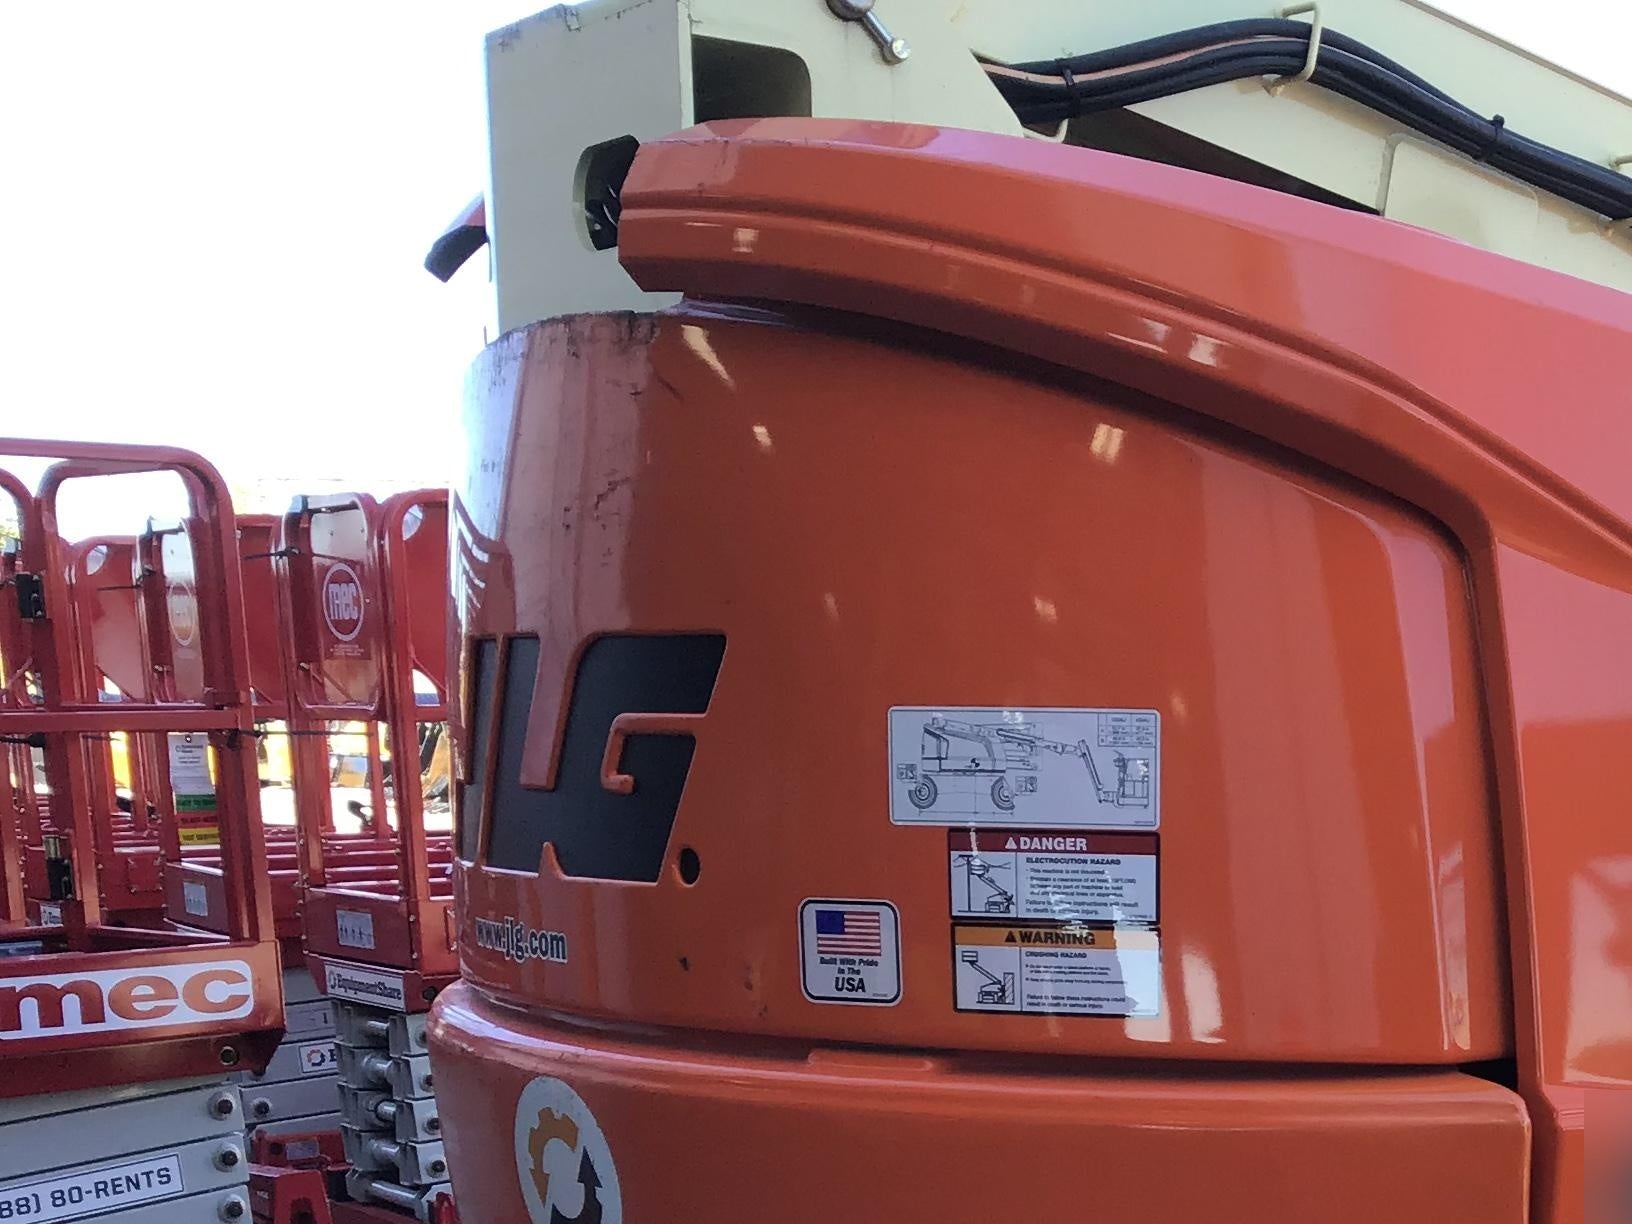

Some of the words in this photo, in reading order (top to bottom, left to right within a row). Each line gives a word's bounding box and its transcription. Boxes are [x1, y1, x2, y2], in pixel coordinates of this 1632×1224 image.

[1019, 836, 1088, 851] DANGER
[1090, 858, 1121, 866] HAZARD
[476, 917, 568, 962] www.jlg.com
[1019, 930, 1096, 946] WARNING
[834, 976, 866, 993] USA
[0, 968, 251, 1033] mec
[50, 1166, 173, 1208] 80-RENTS
